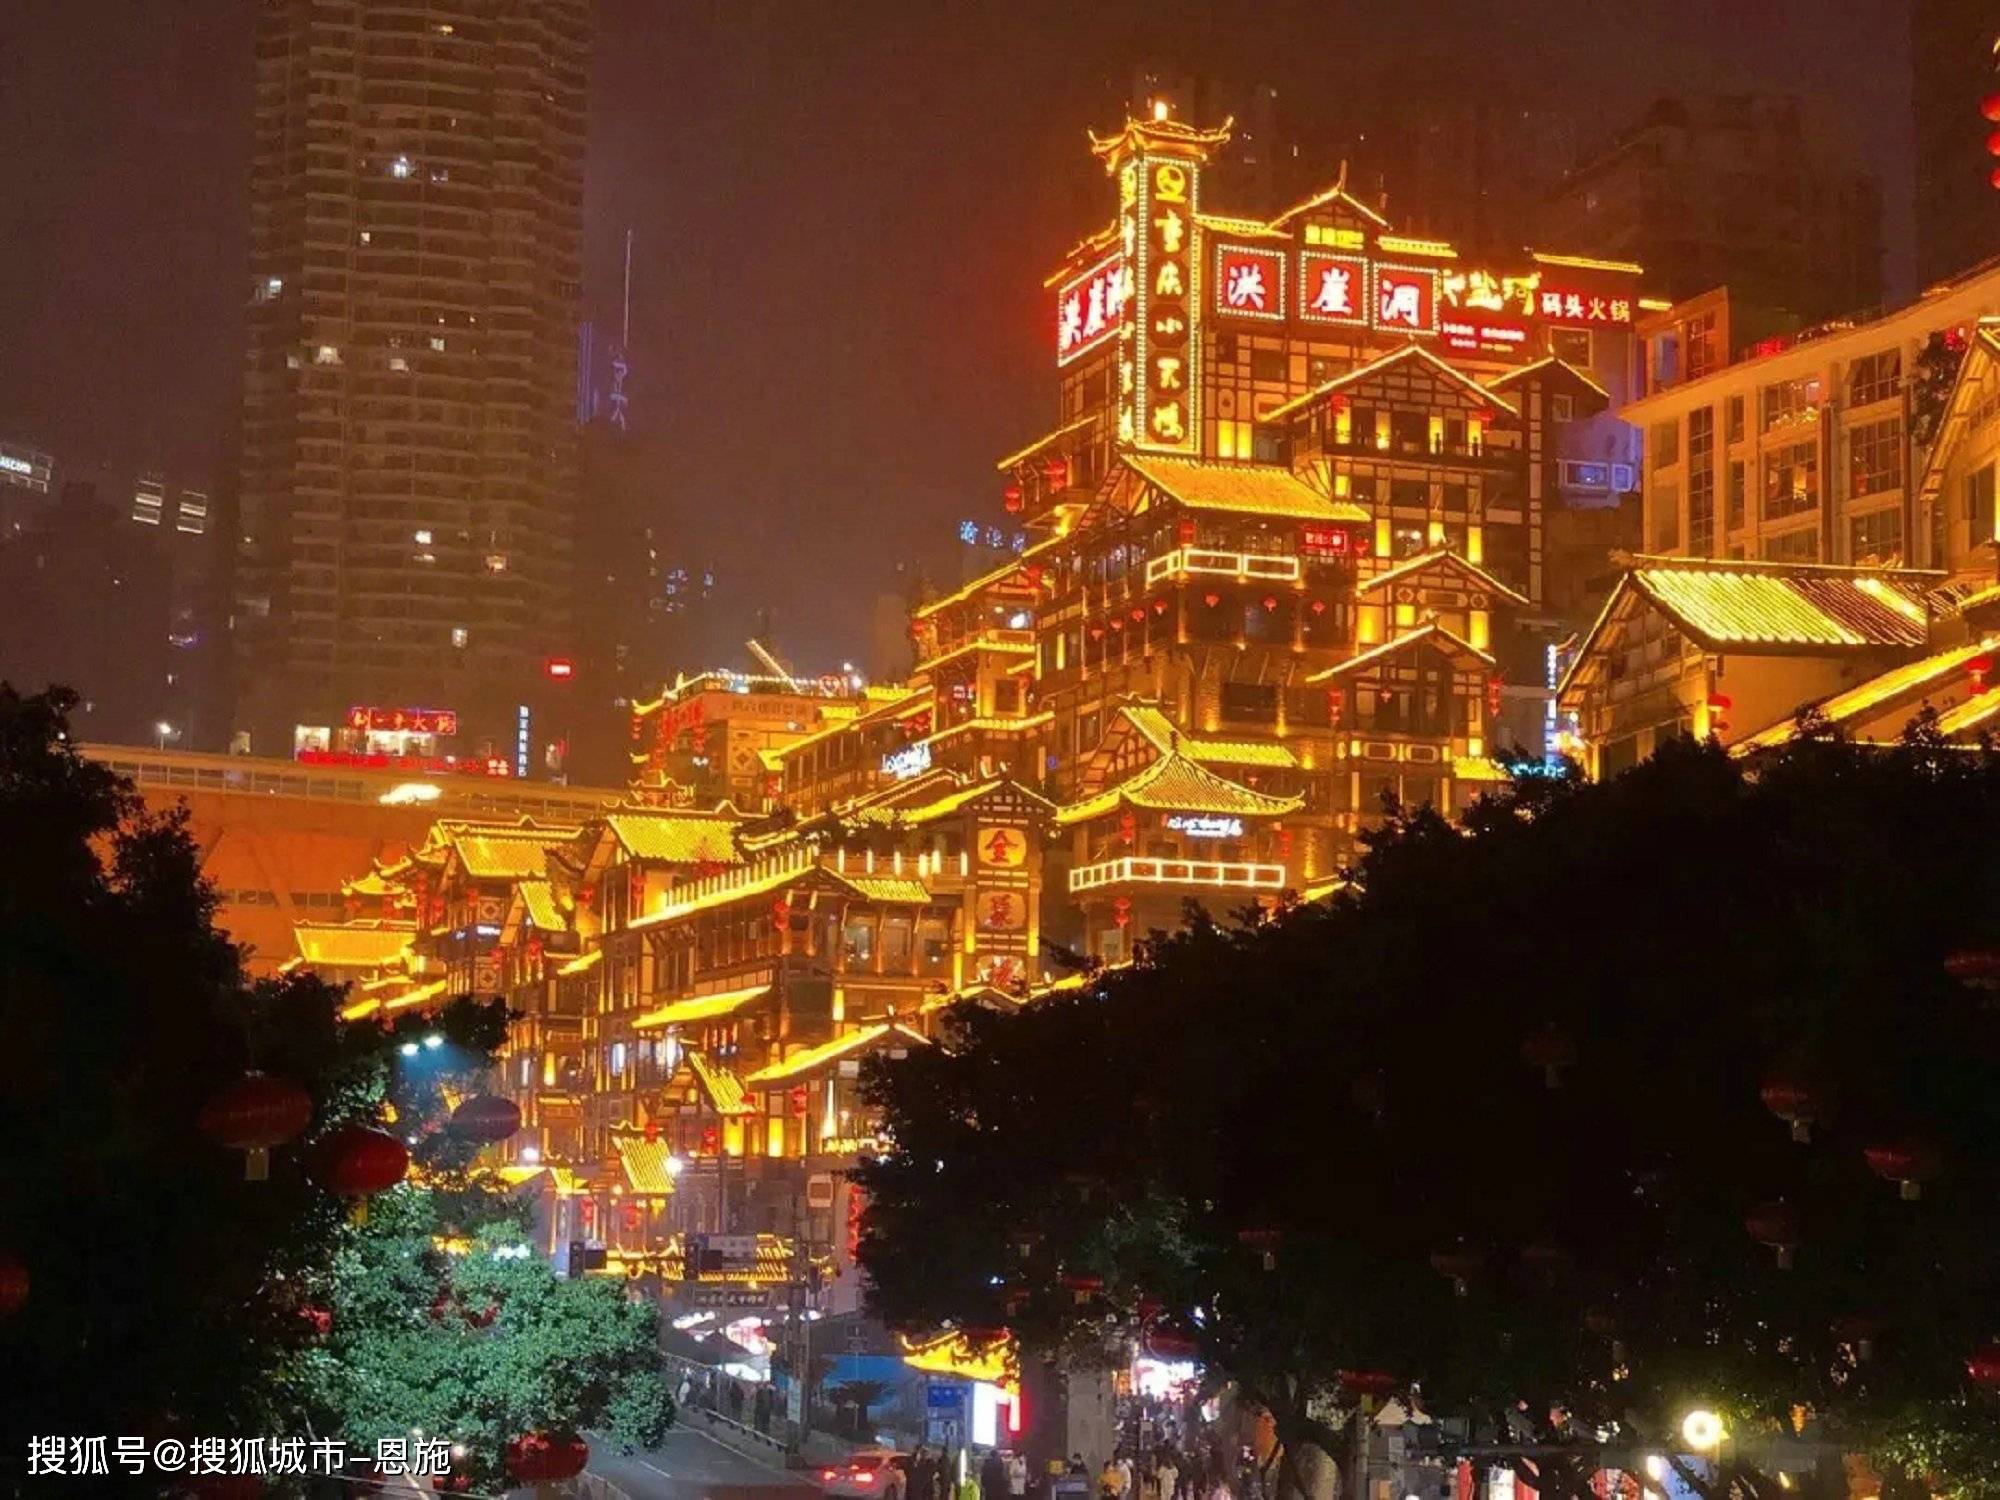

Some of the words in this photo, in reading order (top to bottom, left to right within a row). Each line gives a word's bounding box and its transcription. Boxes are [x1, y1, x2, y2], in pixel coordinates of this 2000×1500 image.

[1227, 264, 1421, 327] 洪崖洞
[1541, 293, 1631, 322] 码头火锅
